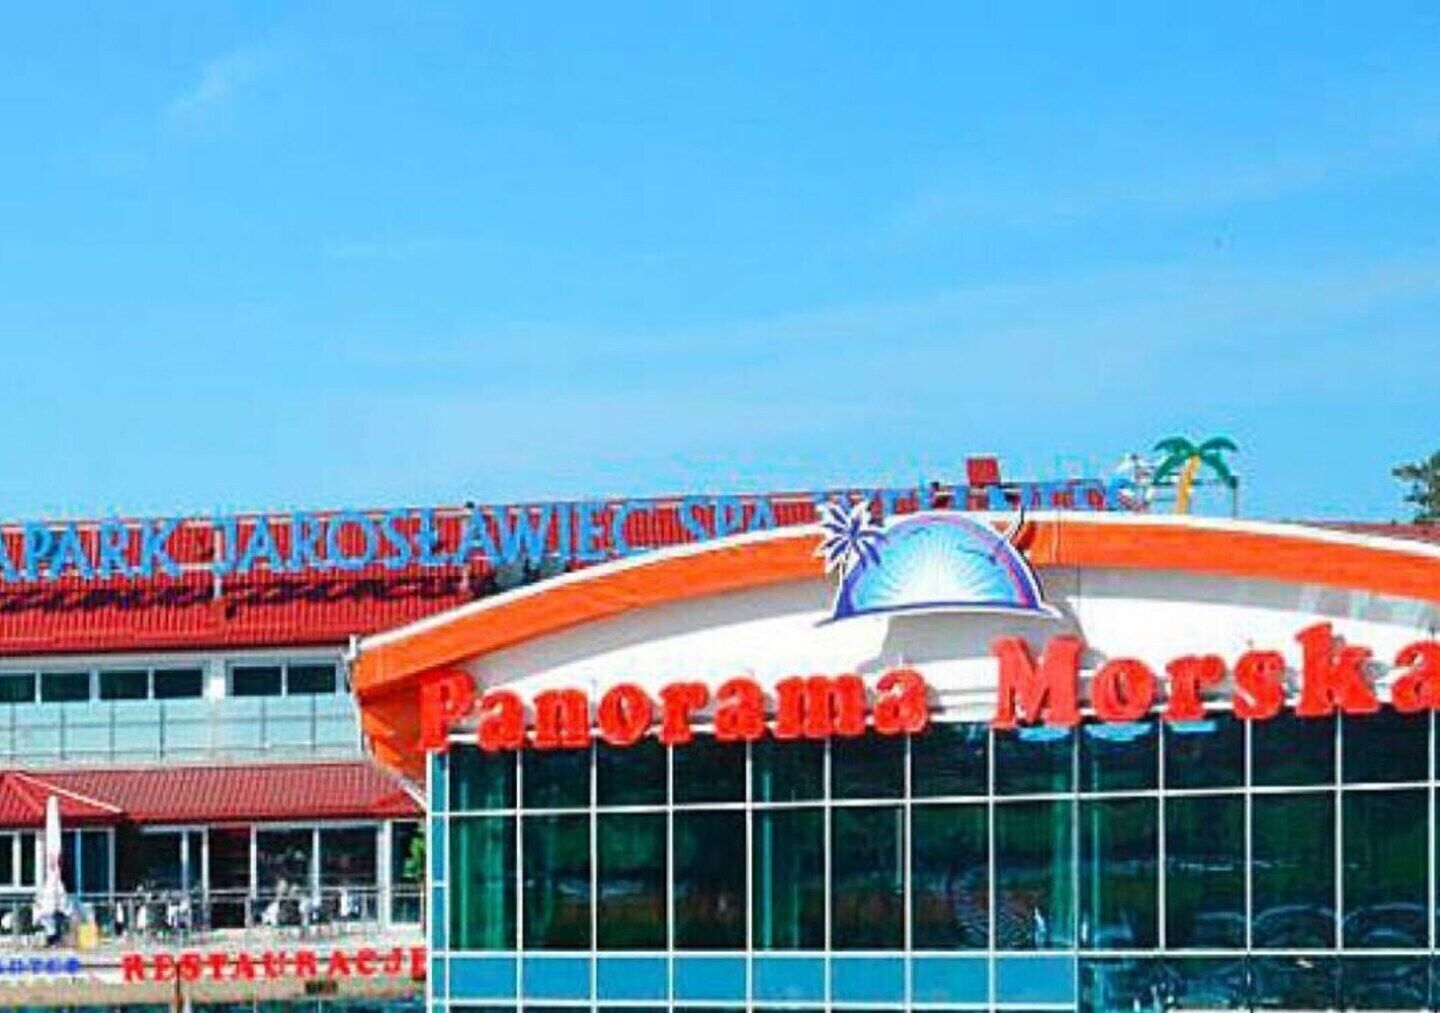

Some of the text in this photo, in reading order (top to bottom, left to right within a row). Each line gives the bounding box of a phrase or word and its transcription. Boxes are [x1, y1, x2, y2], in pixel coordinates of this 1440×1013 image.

[415, 622, 1440, 751] Panorama Morska
[122, 946, 427, 983] RESTAURACJE
